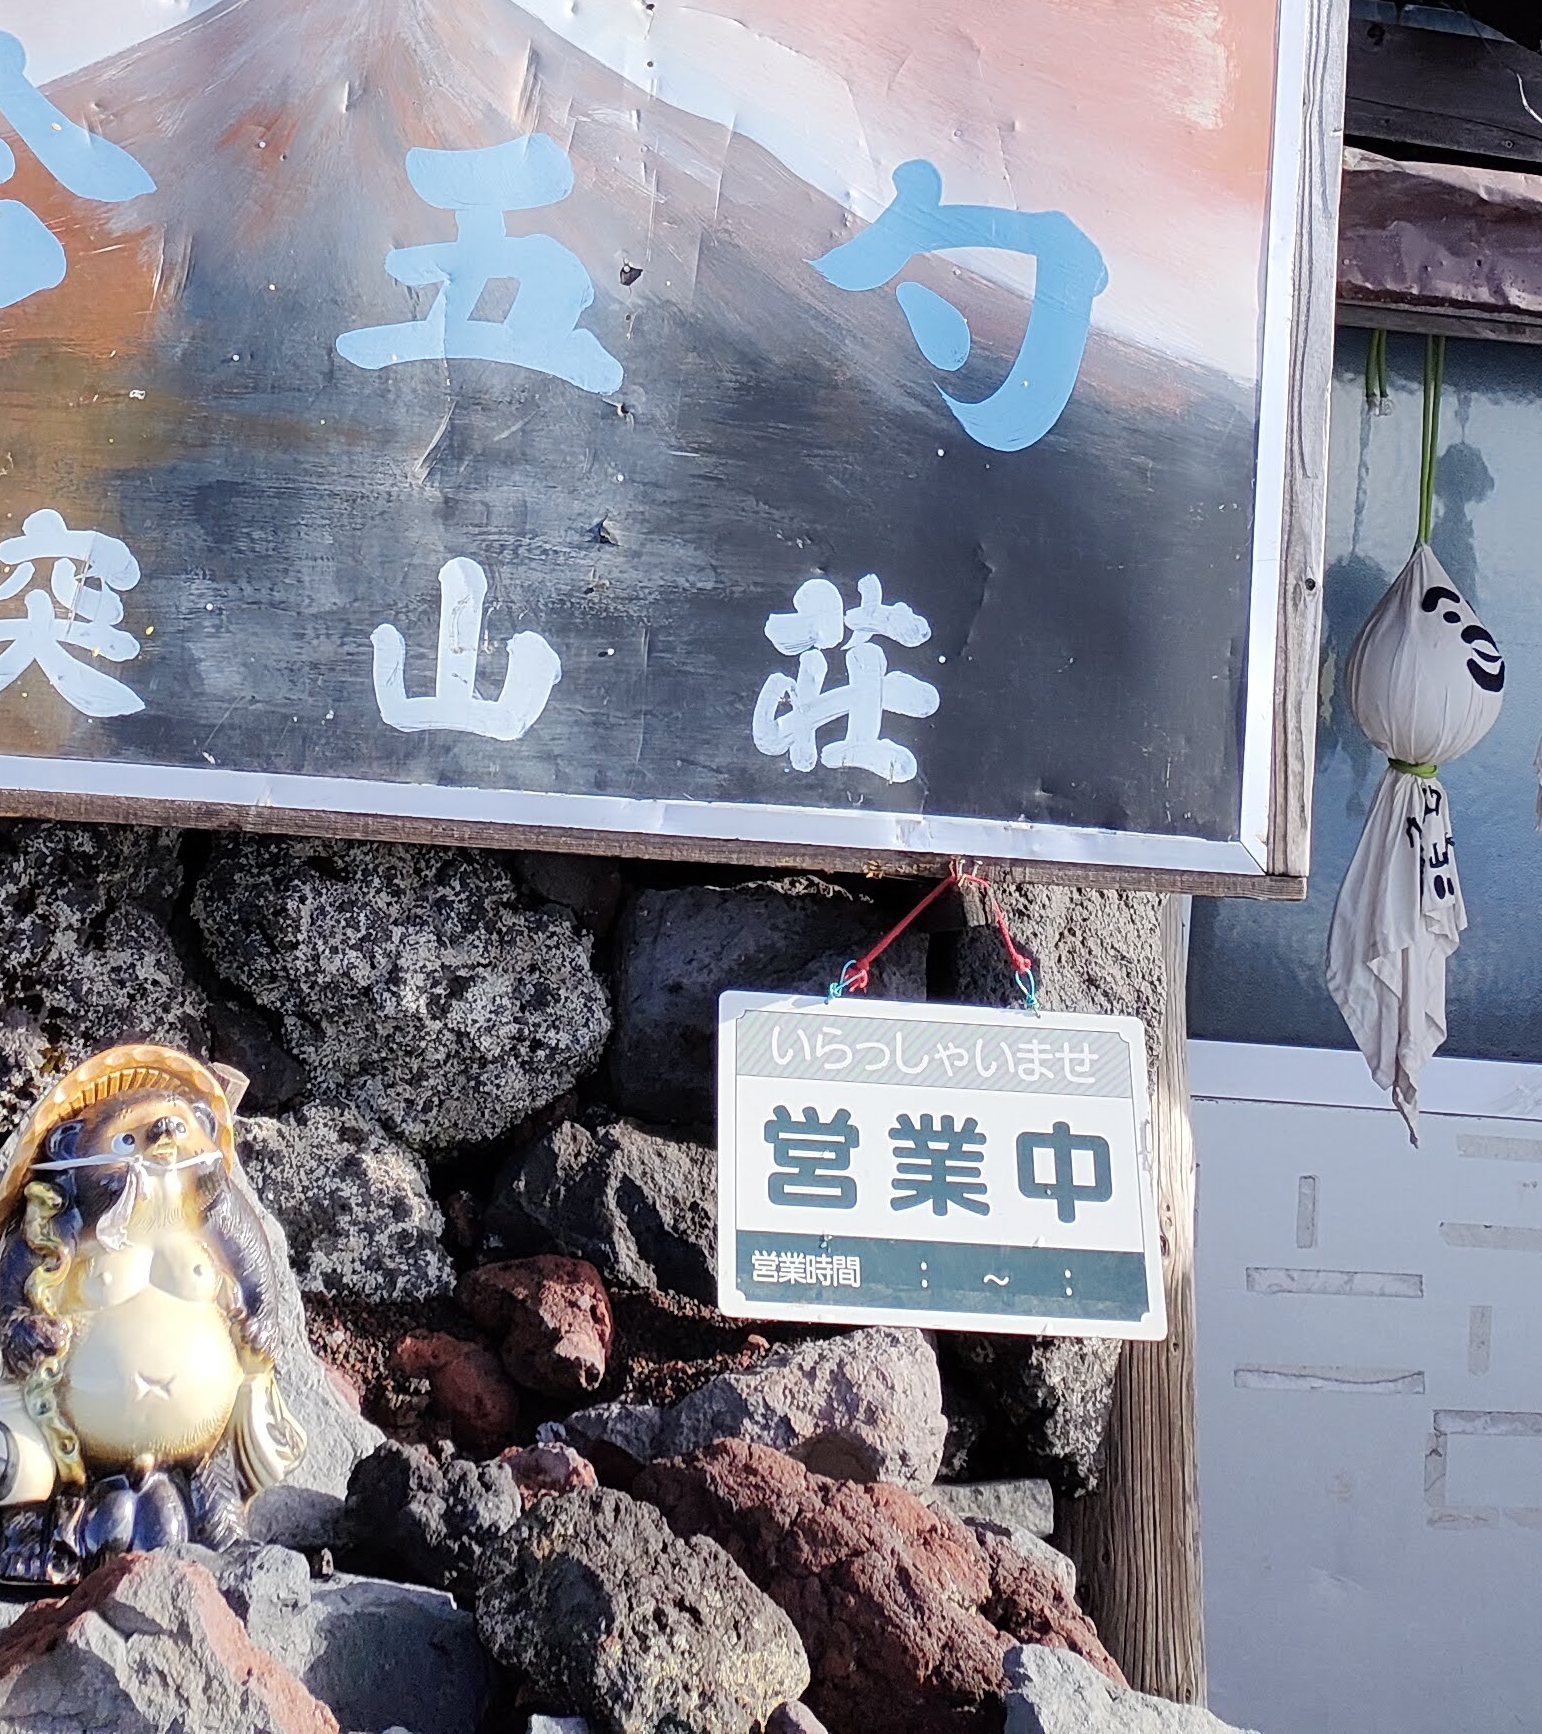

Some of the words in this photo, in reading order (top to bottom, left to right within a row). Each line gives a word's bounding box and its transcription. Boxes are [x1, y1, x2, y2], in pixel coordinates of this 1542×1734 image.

[771, 1025, 1099, 1085] いらっしゃいませ
[763, 1103, 1114, 1225] 営業中
[751, 1249, 861, 1290] 営業時間
